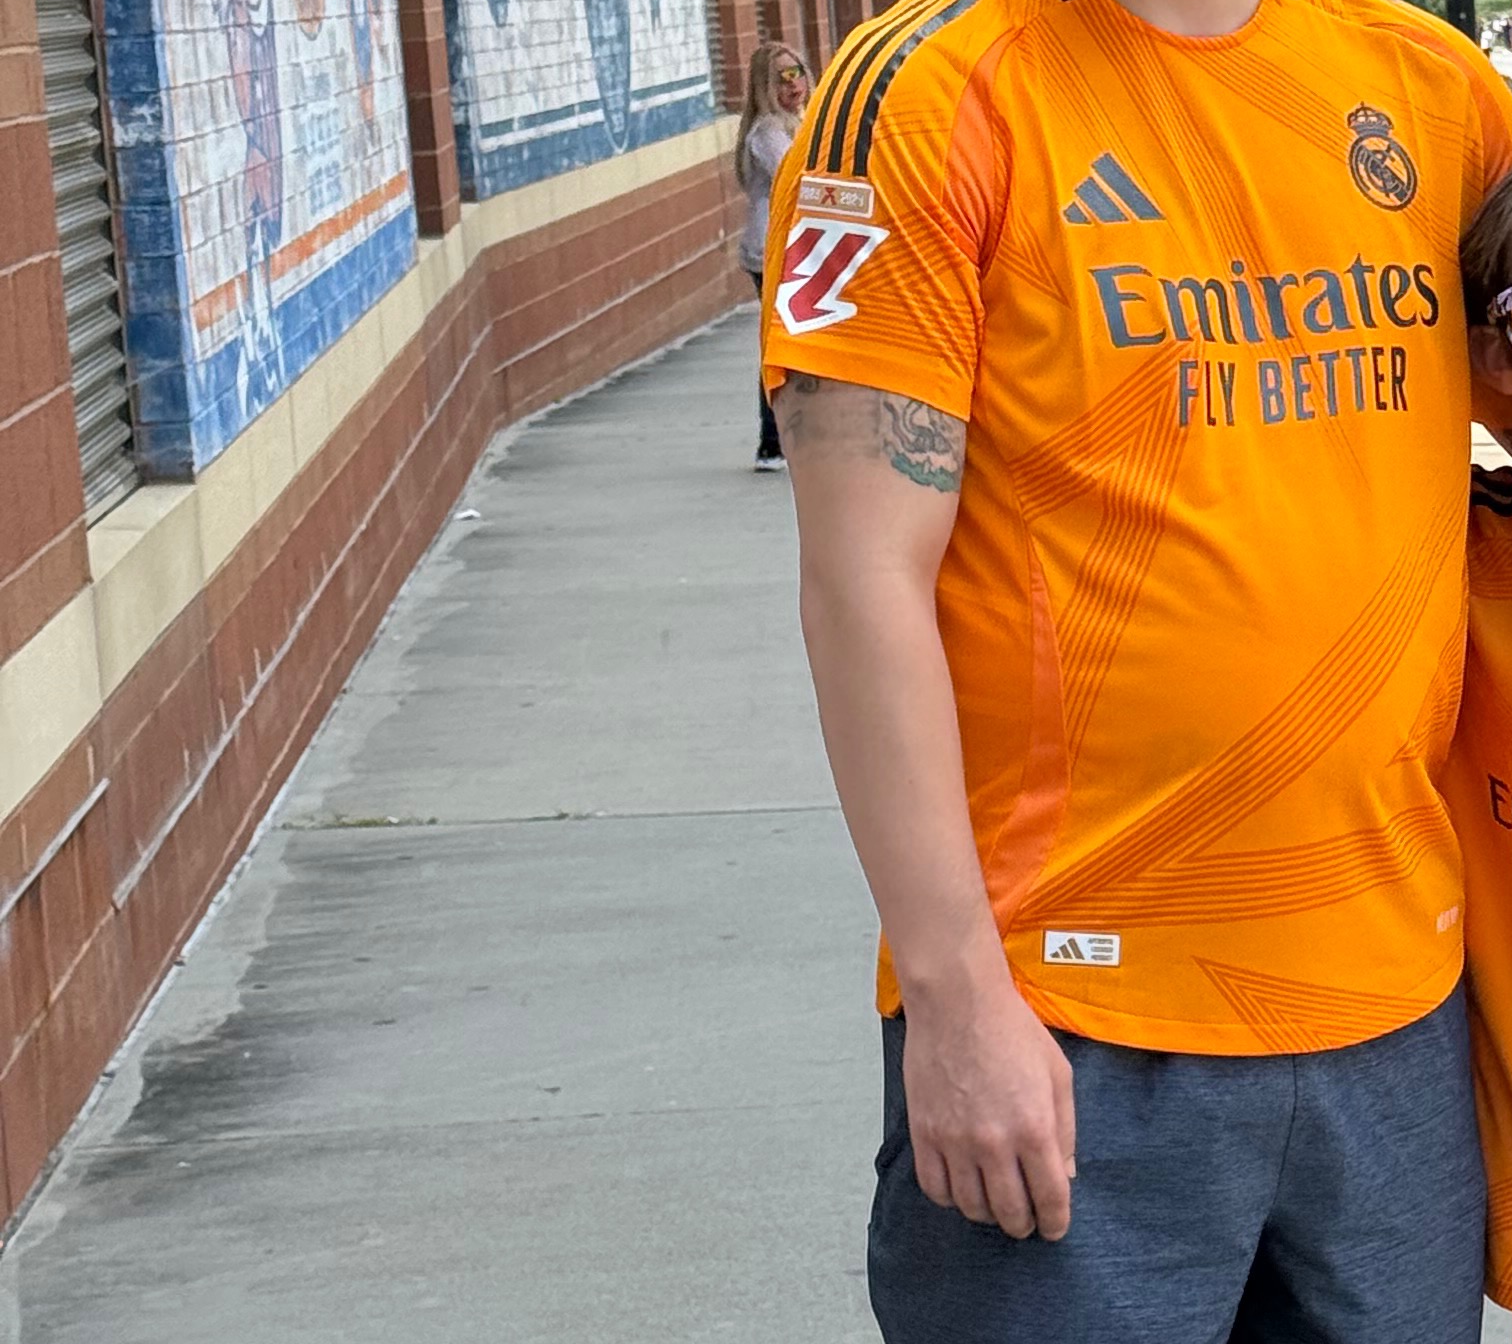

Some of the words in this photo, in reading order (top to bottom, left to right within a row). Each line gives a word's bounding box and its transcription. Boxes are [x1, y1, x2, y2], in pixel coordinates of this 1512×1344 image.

[1088, 253, 1440, 349] Emirates
[1178, 359, 1236, 428] FLY
[1258, 346, 1408, 425] BETTER
